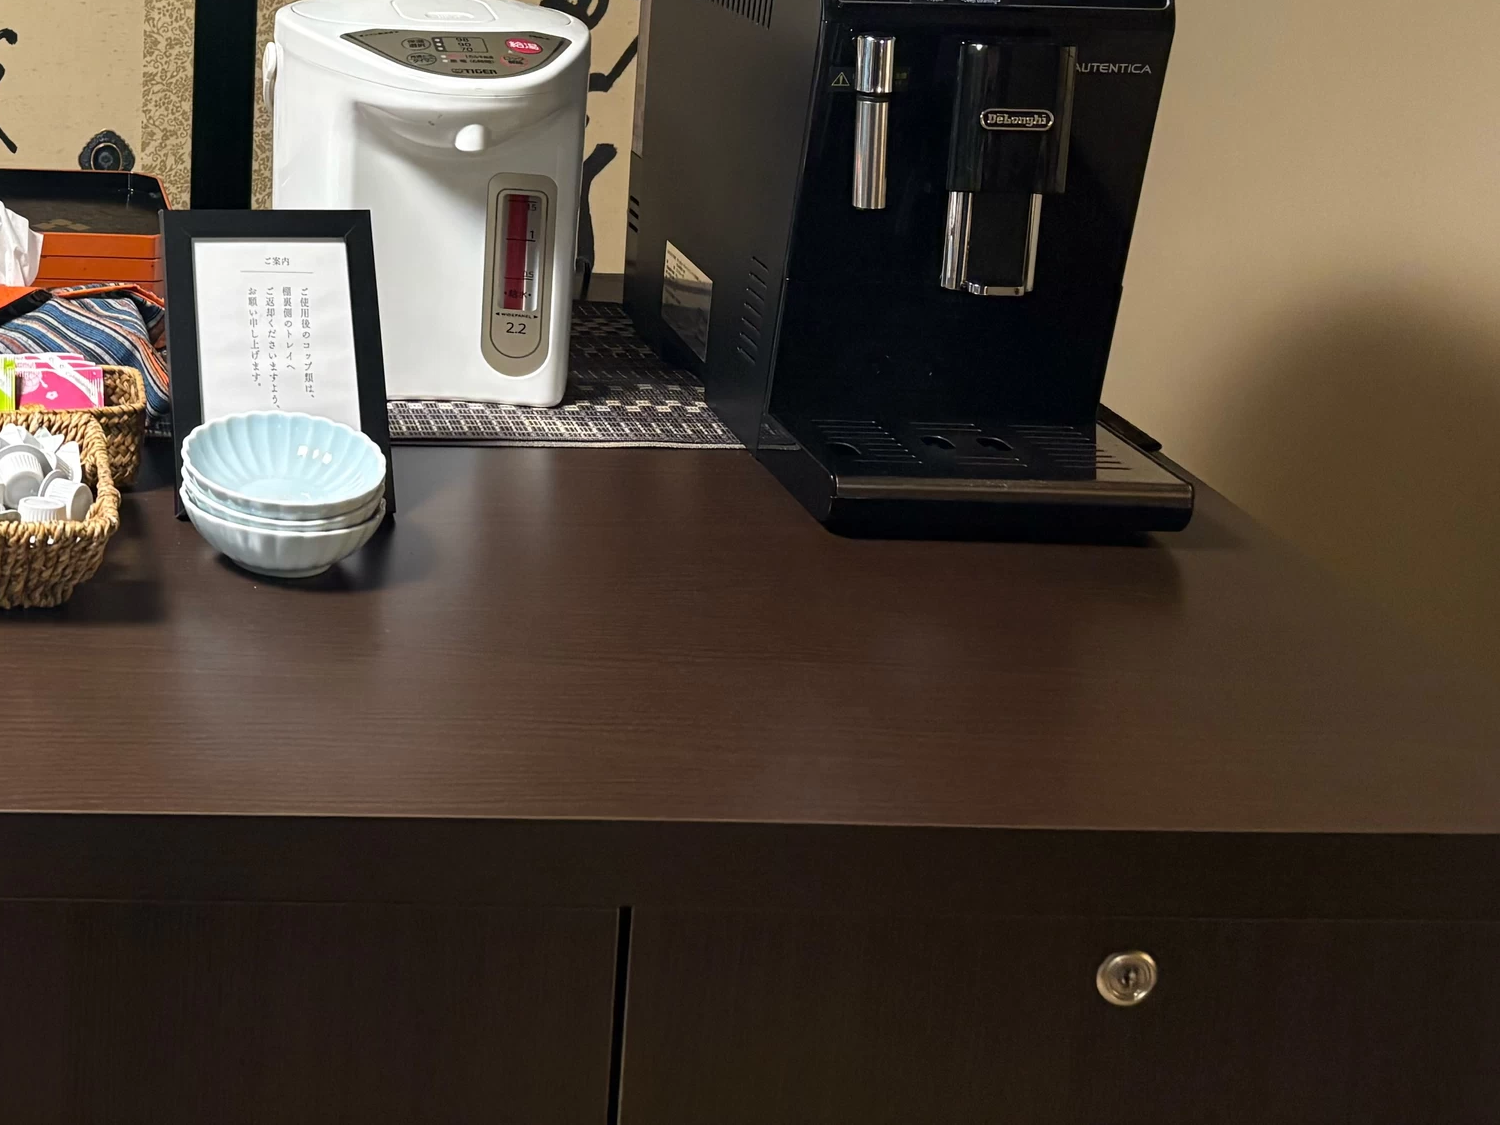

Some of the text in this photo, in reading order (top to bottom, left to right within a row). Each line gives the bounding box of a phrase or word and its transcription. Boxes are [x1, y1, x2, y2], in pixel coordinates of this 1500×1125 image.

[1074, 63, 1152, 74] AUTENTICA
[264, 256, 290, 266] ご案内
[248, 287, 261, 387] お願い申し上げます。
[265, 287, 280, 408] ご返却くださいますよう、
[282, 286, 295, 370] 棚裏側のトレイへ
[299, 287, 315, 398] ご使用後のコップ類は、
[506, 322, 527, 335] 2.2
